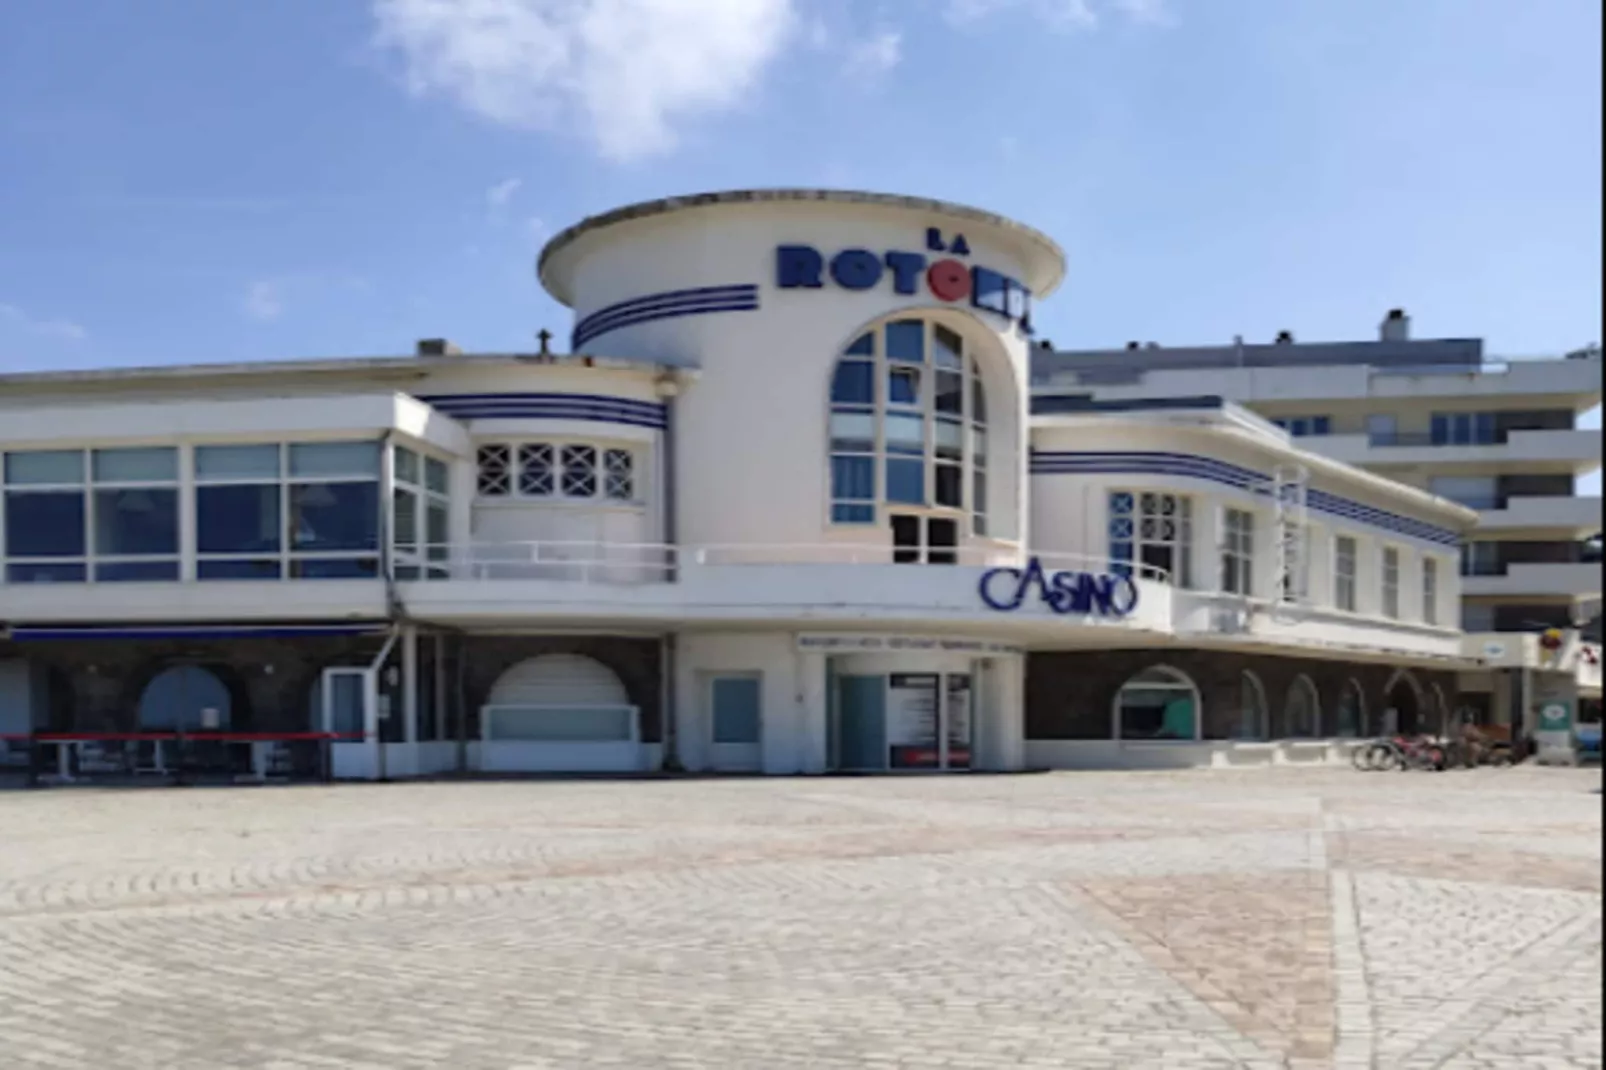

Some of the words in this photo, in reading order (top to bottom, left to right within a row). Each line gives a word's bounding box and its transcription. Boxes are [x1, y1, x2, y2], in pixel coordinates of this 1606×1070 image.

[926, 227, 970, 256] LA
[776, 244, 1034, 334] ROTO
[979, 556, 1138, 616] CASINO
